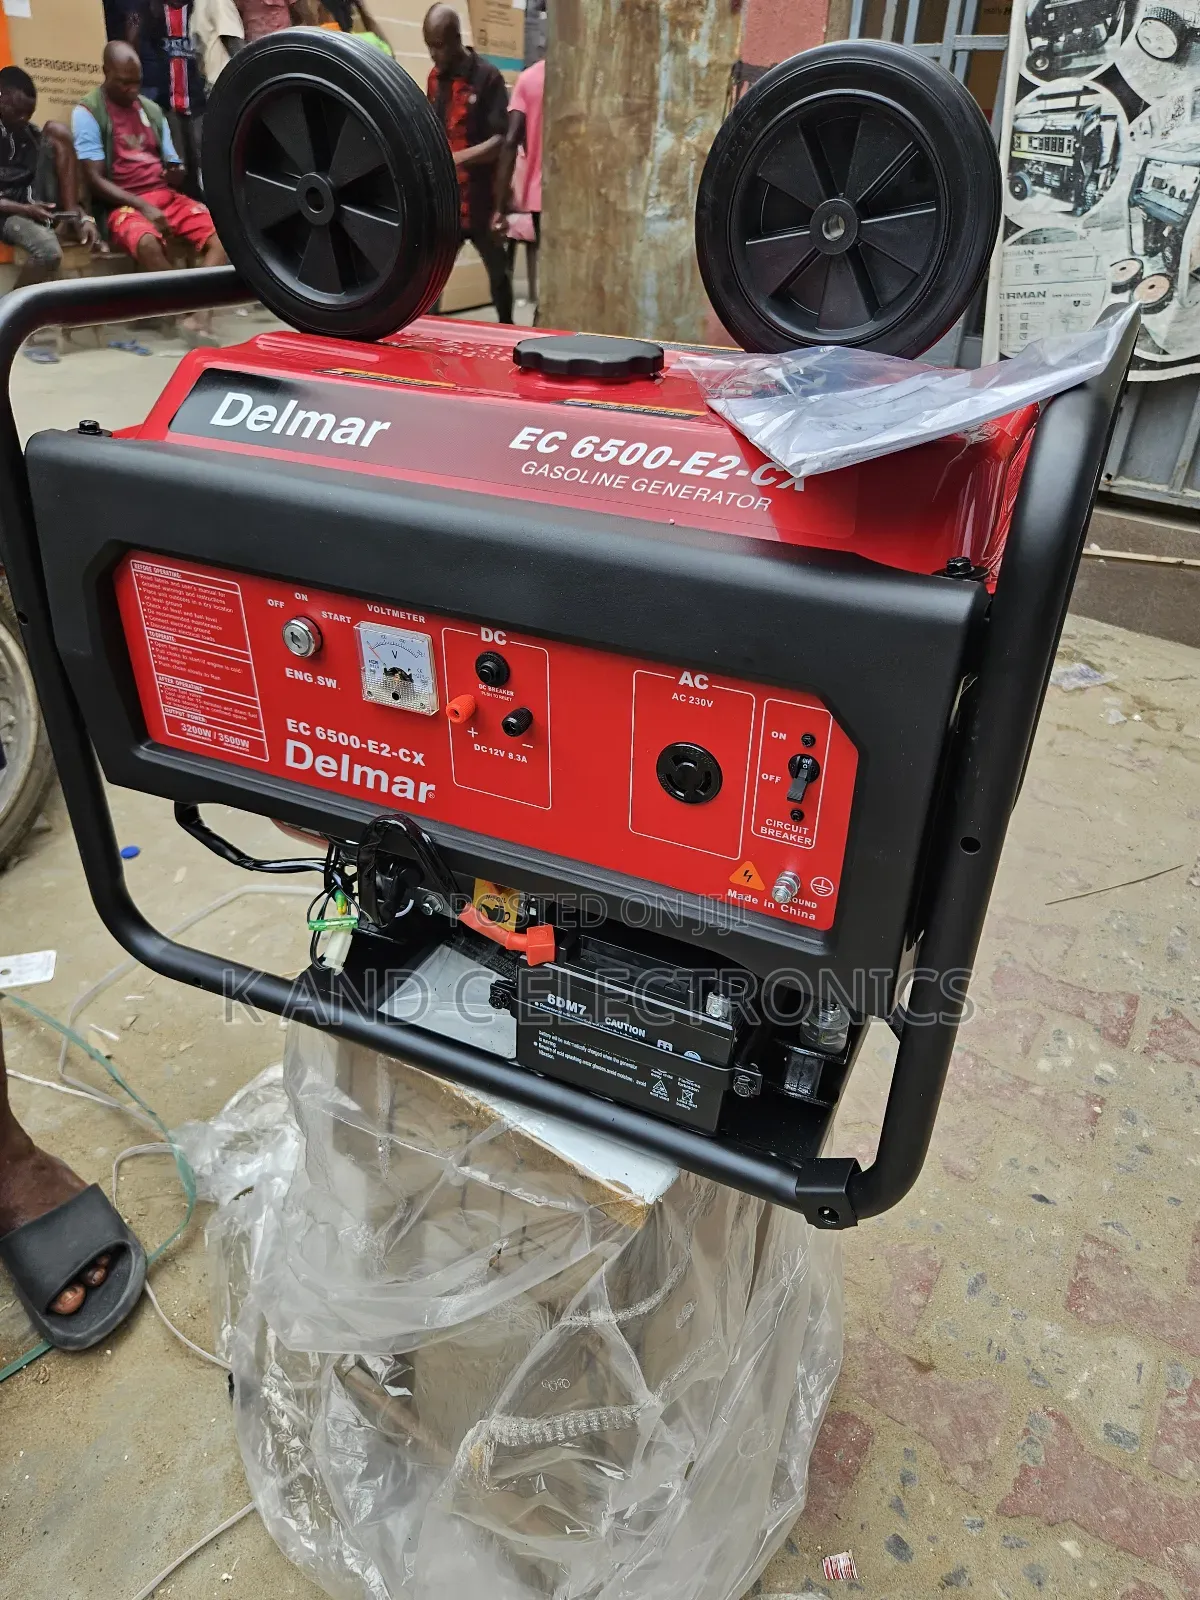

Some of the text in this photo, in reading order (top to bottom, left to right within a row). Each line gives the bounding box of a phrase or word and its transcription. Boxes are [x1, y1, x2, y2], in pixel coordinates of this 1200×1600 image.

[210, 392, 391, 448] Delmar
[509, 426, 806, 492] EC 6500-E2-CX
[521, 461, 772, 511] GASOLINE GENERATOR
[134, 563, 151, 572] BEFORE
[294, 592, 308, 601] ON
[267, 598, 351, 623] OFF START
[367, 604, 426, 623] VOLTMETER
[480, 627, 507, 645] DC
[391, 650, 398, 659] V
[678, 671, 709, 690] AC
[487, 685, 514, 696] BREAKER
[671, 692, 714, 708] AC 230V
[164, 708, 185, 716] OUTPUT
[180, 722, 212, 737] 3200W
[218, 733, 250, 748] 3500W
[286, 718, 426, 766] EC 6500-E2-CX
[771, 731, 787, 740] ON
[508, 752, 528, 763] 8.3A
[285, 739, 436, 804] Delmar
[761, 773, 782, 784] OFF
[760, 826, 812, 846] BREAKER
[765, 818, 809, 835] CIRCUIT
[727, 888, 816, 920] Made in China
[547, 994, 587, 1015] 6DM7
[605, 1016, 646, 1038] CAUTION
